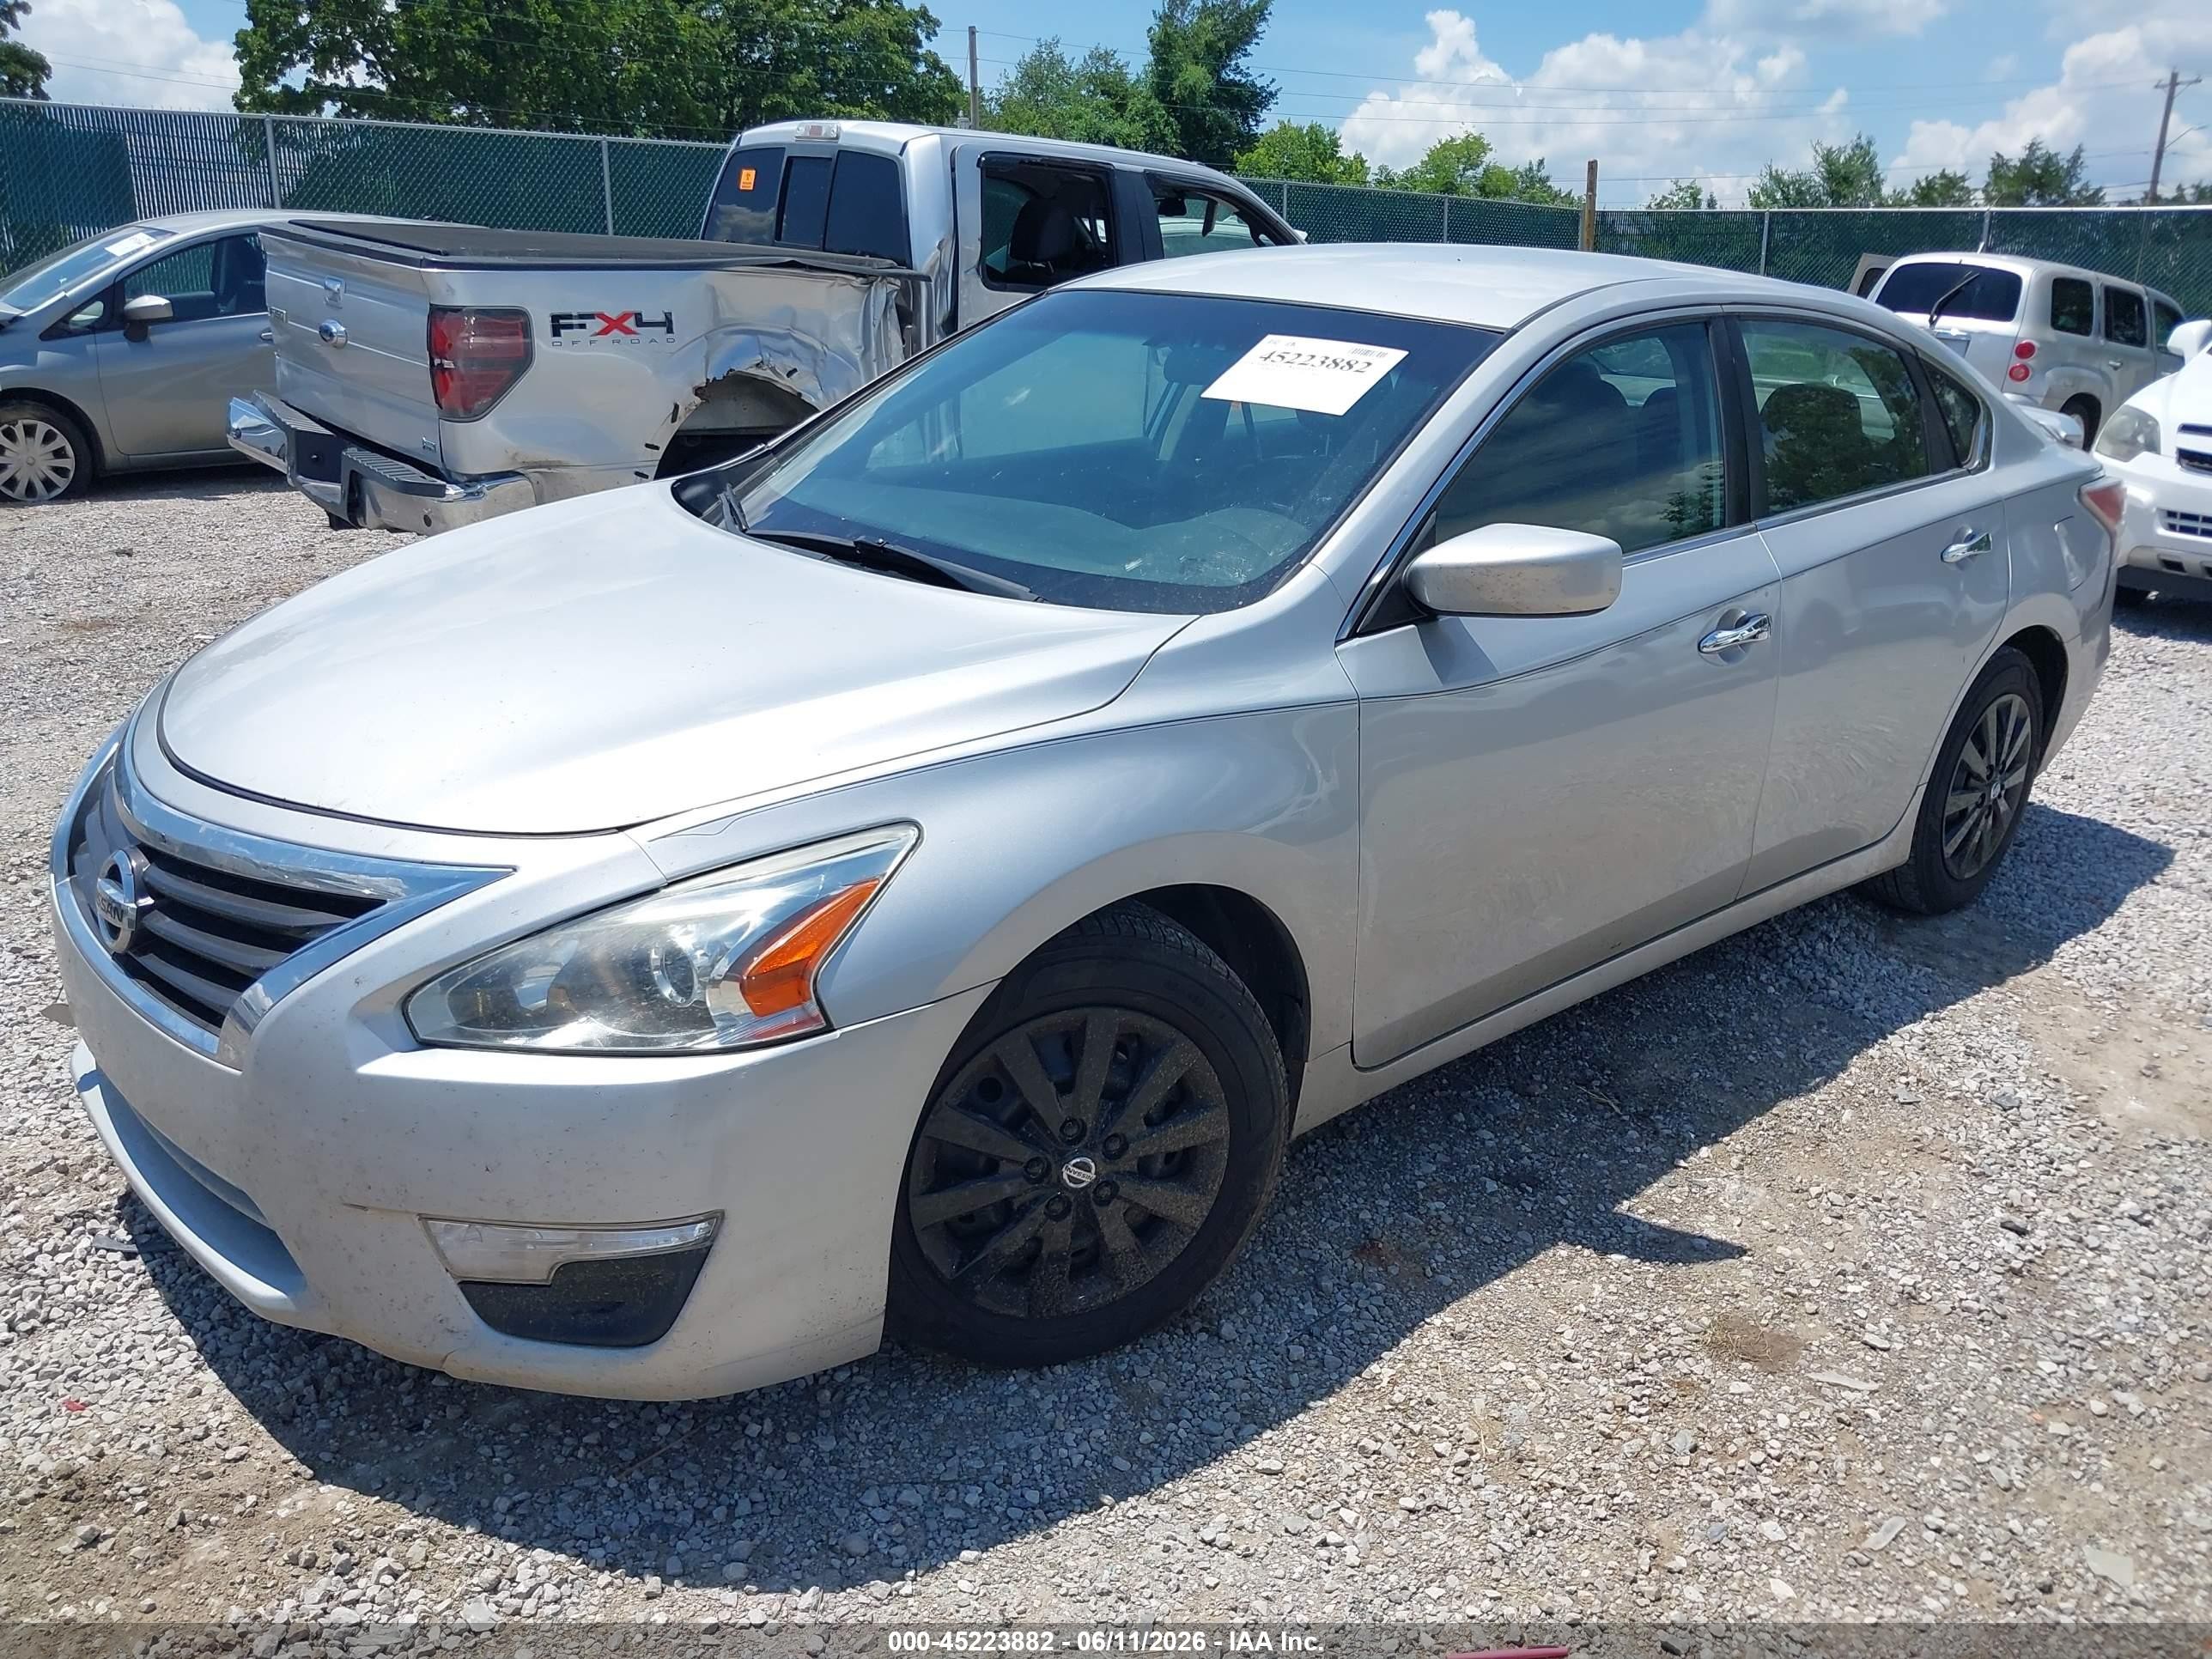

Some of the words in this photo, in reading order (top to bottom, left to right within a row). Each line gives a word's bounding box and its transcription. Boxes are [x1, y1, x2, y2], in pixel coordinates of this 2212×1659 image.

[550, 311, 675, 337] FX4
[1259, 349, 1374, 374] 45223882
[96, 893, 125, 922] SSAN
[1066, 1166, 1093, 1181] NISSAN
